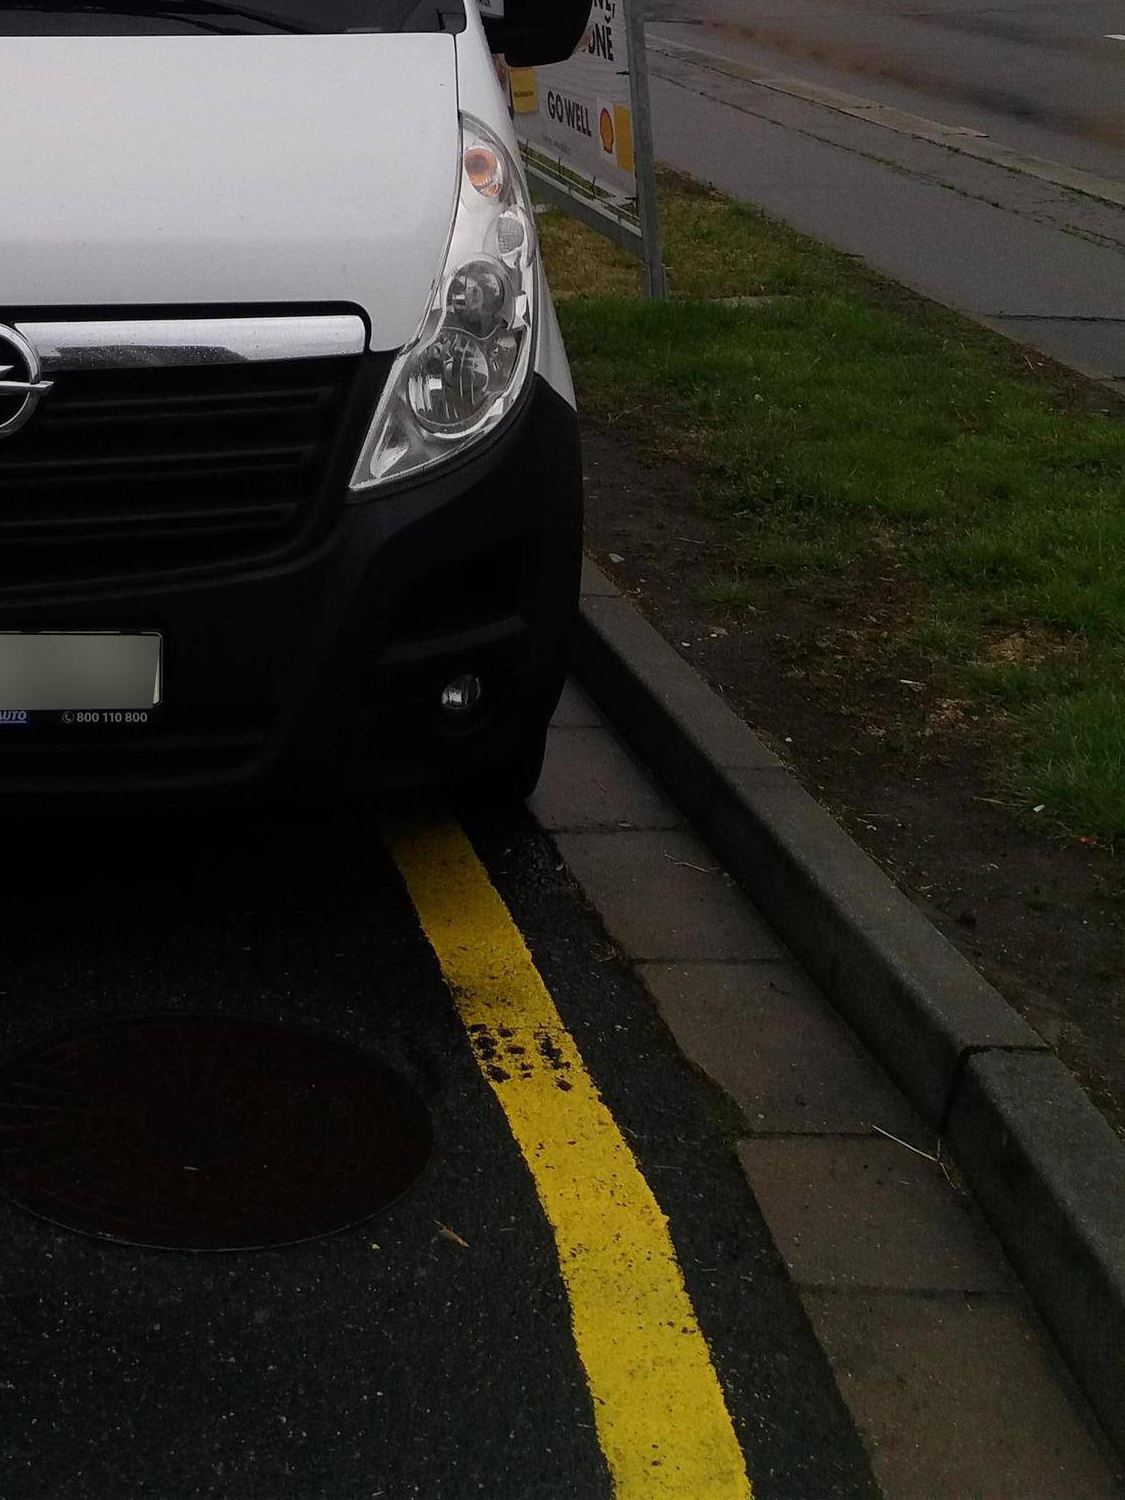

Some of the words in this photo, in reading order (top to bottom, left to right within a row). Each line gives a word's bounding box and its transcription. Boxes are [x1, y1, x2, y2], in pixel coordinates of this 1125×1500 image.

[547, 90, 564, 123] GO
[564, 98, 592, 138] WELL
[76, 712, 100, 724] 800
[102, 712, 121, 724] 110
[123, 712, 148, 724] 800
